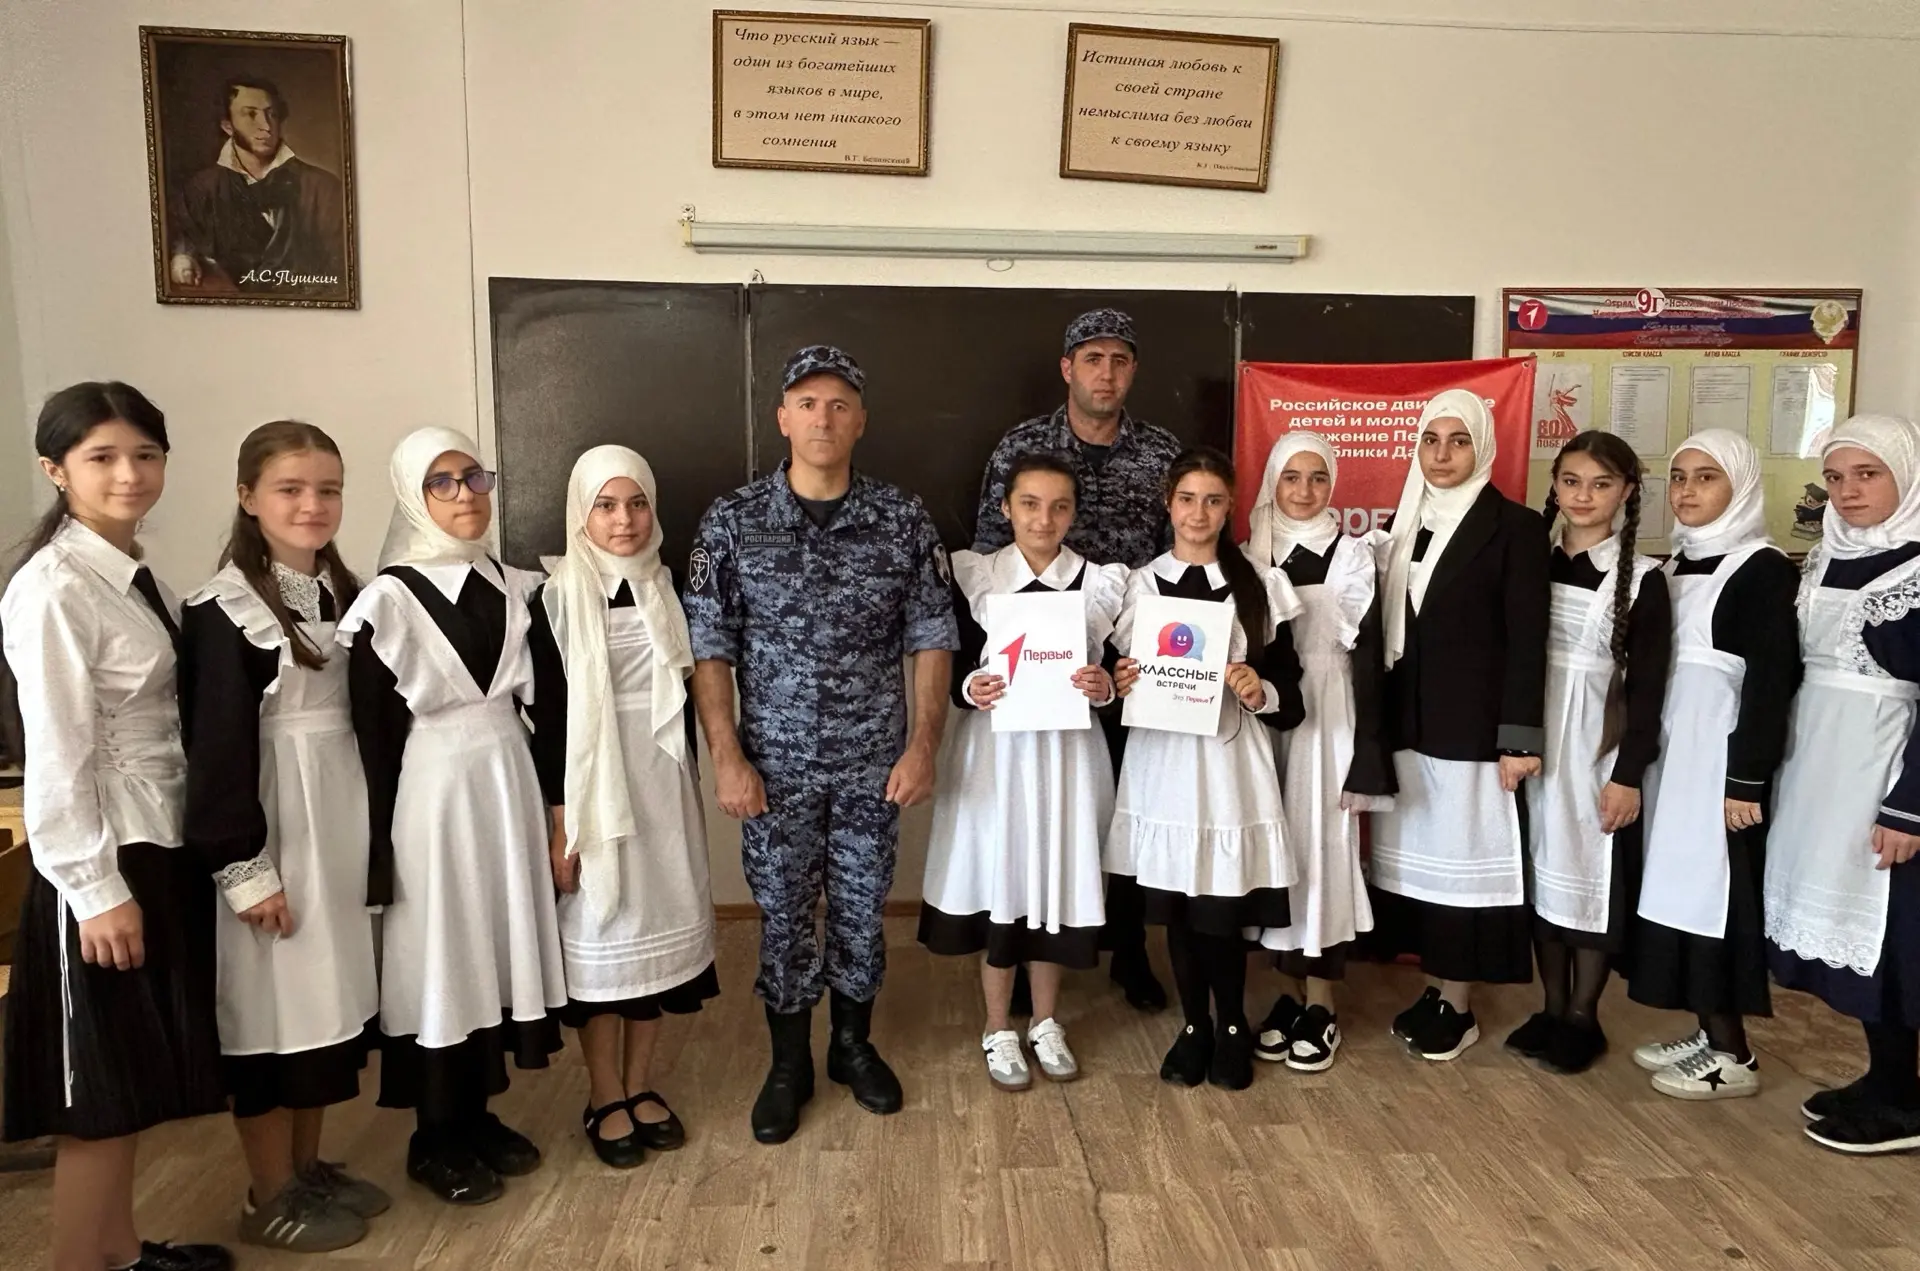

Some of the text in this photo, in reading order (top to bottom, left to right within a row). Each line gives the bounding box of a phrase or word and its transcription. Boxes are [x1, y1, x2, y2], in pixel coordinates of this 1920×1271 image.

[734, 28, 769, 43] Что
[773, 32, 838, 46] русский
[840, 36, 880, 46] язык
[733, 56, 897, 73] один из богатейших
[1082, 50, 1243, 74] Истинная любовь к
[766, 84, 884, 101] языков в мире,
[1115, 82, 1224, 101] своей стране
[733, 109, 902, 126] в этом нет никакого
[1078, 105, 1253, 129] немыслима без любви
[762, 135, 838, 149] сомнения
[1111, 135, 1232, 157] к своему языку
[239, 269, 338, 286] А.С.Пушкин
[1269, 398, 1388, 412] Российское
[1288, 414, 1422, 428] детей и моло
[1023, 649, 1073, 664] Первые
[1138, 663, 1219, 682] КЛАССНЫЕ
[1156, 680, 1197, 691] ВСТРЕЧИ
